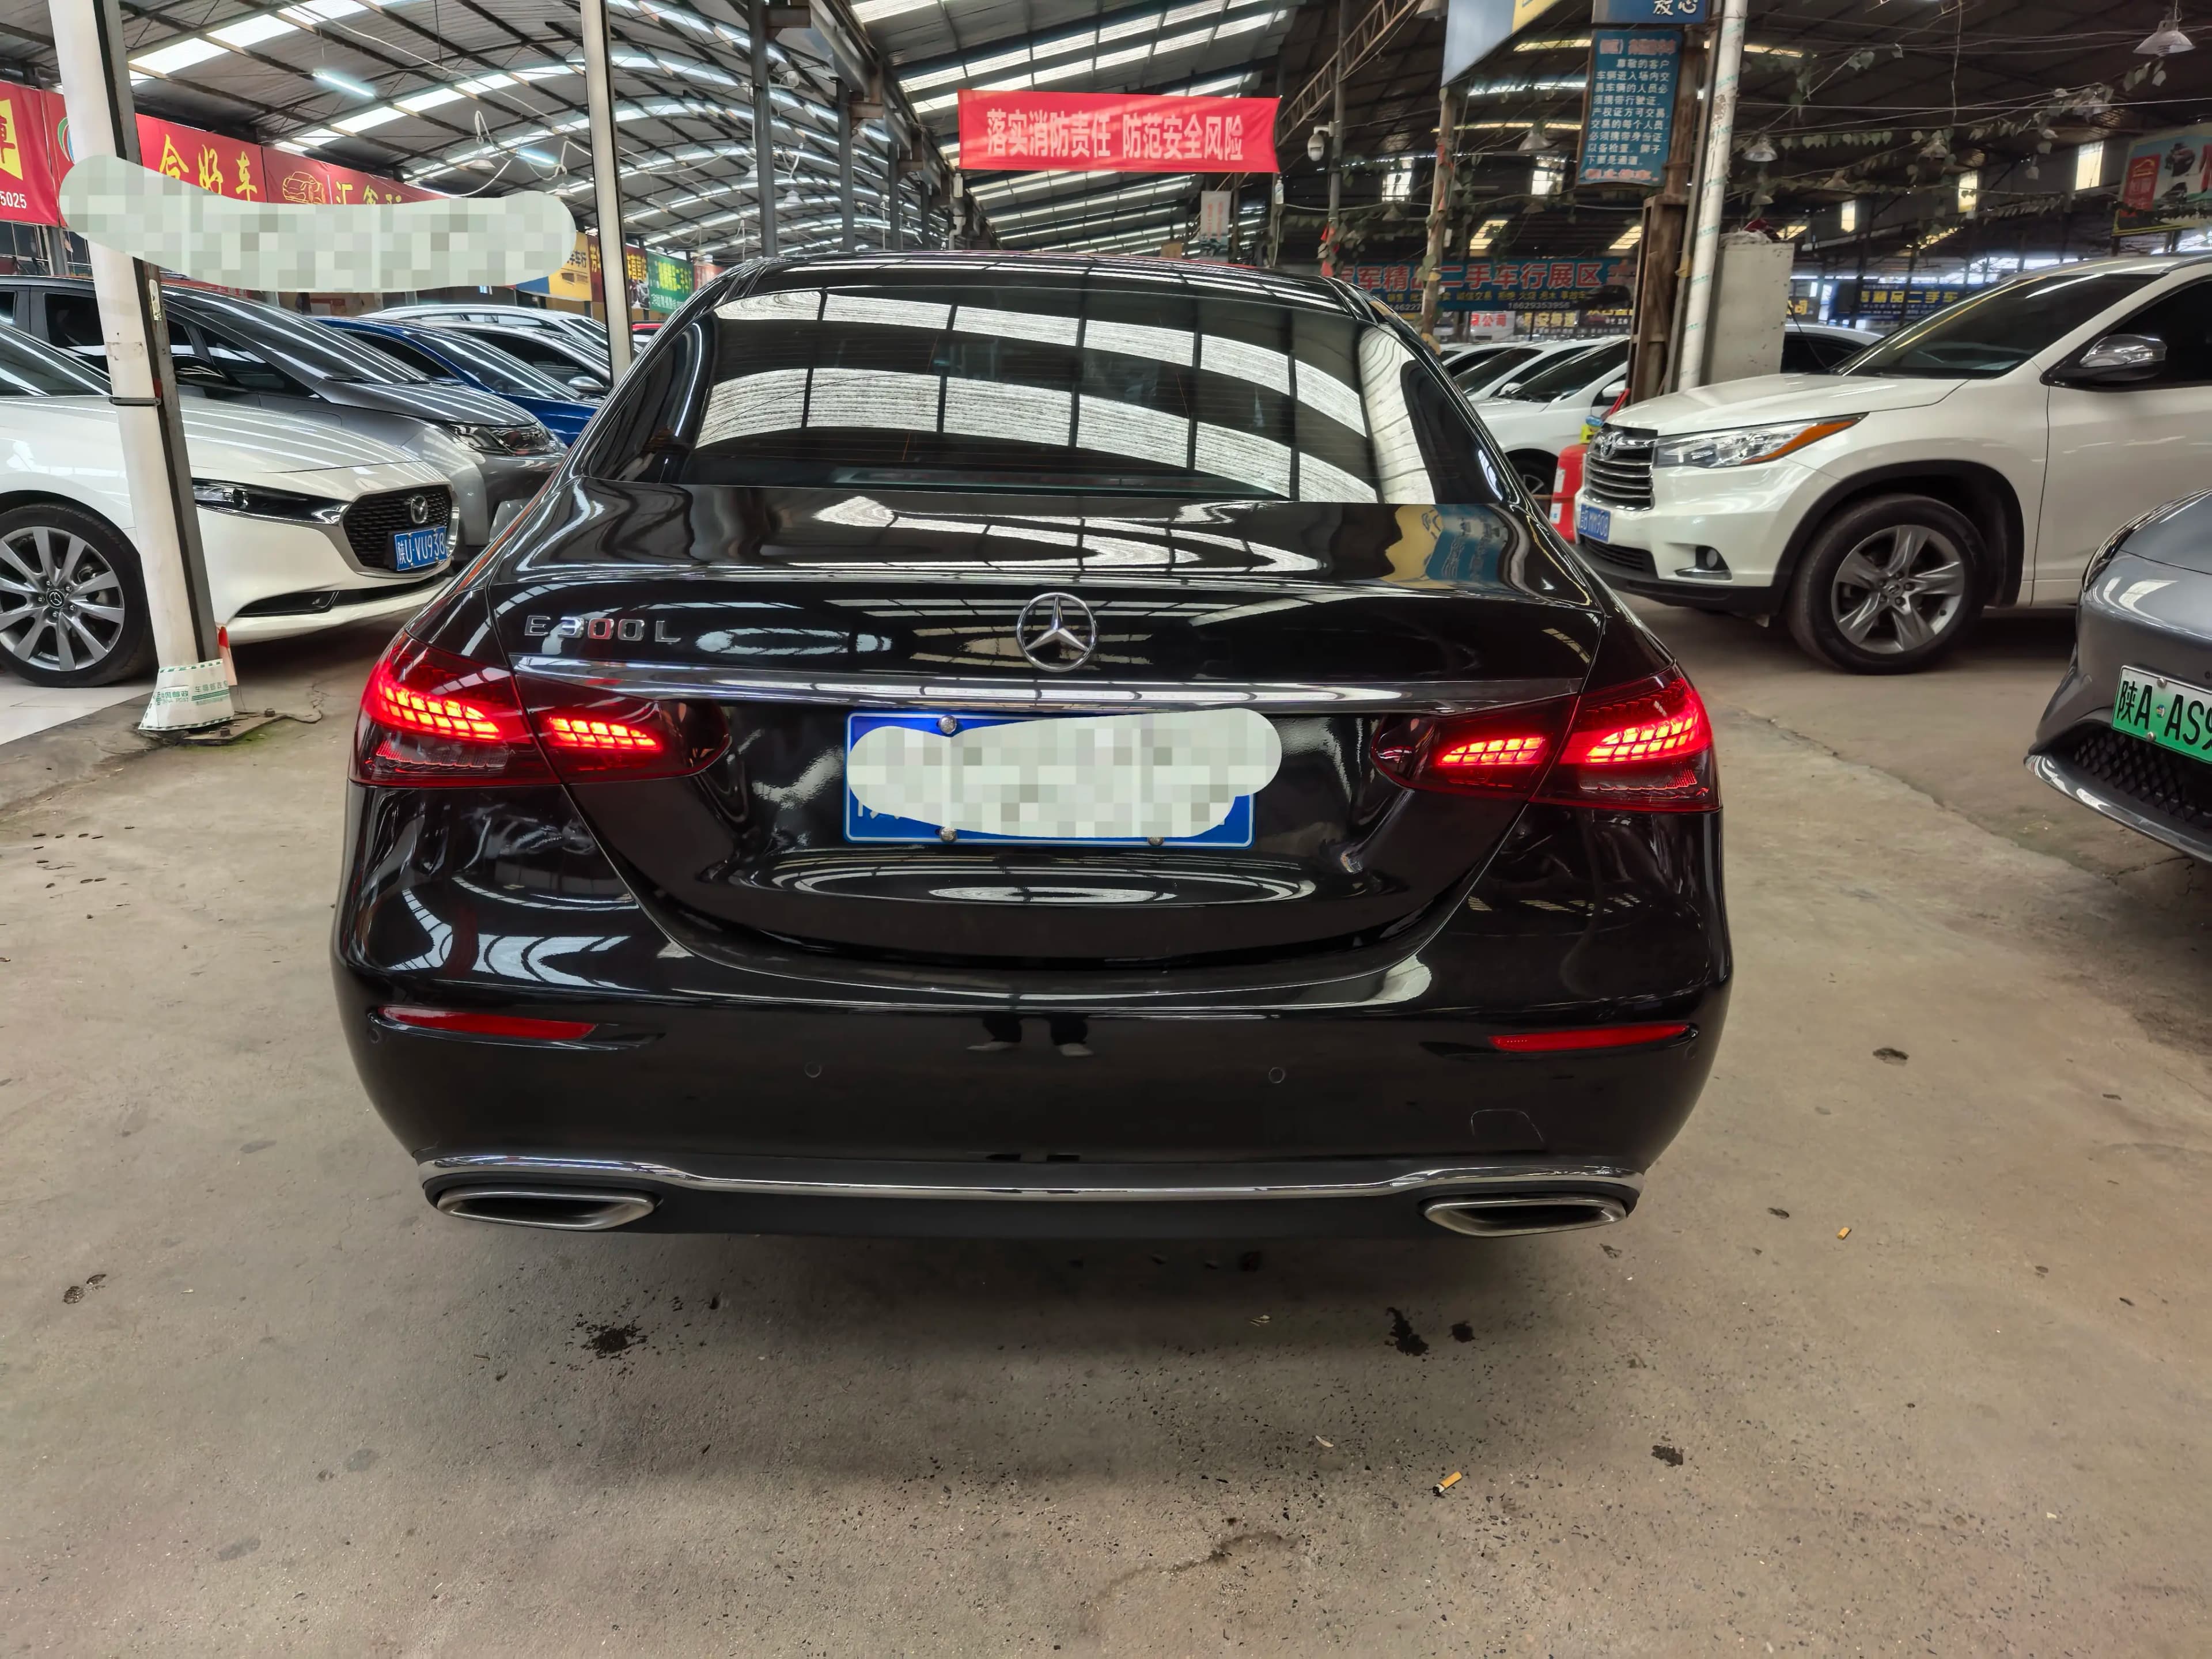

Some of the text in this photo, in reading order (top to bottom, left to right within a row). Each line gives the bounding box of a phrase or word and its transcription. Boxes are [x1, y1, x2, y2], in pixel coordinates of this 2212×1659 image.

[986, 108, 1244, 162] 落实消防责任 防范安全风险
